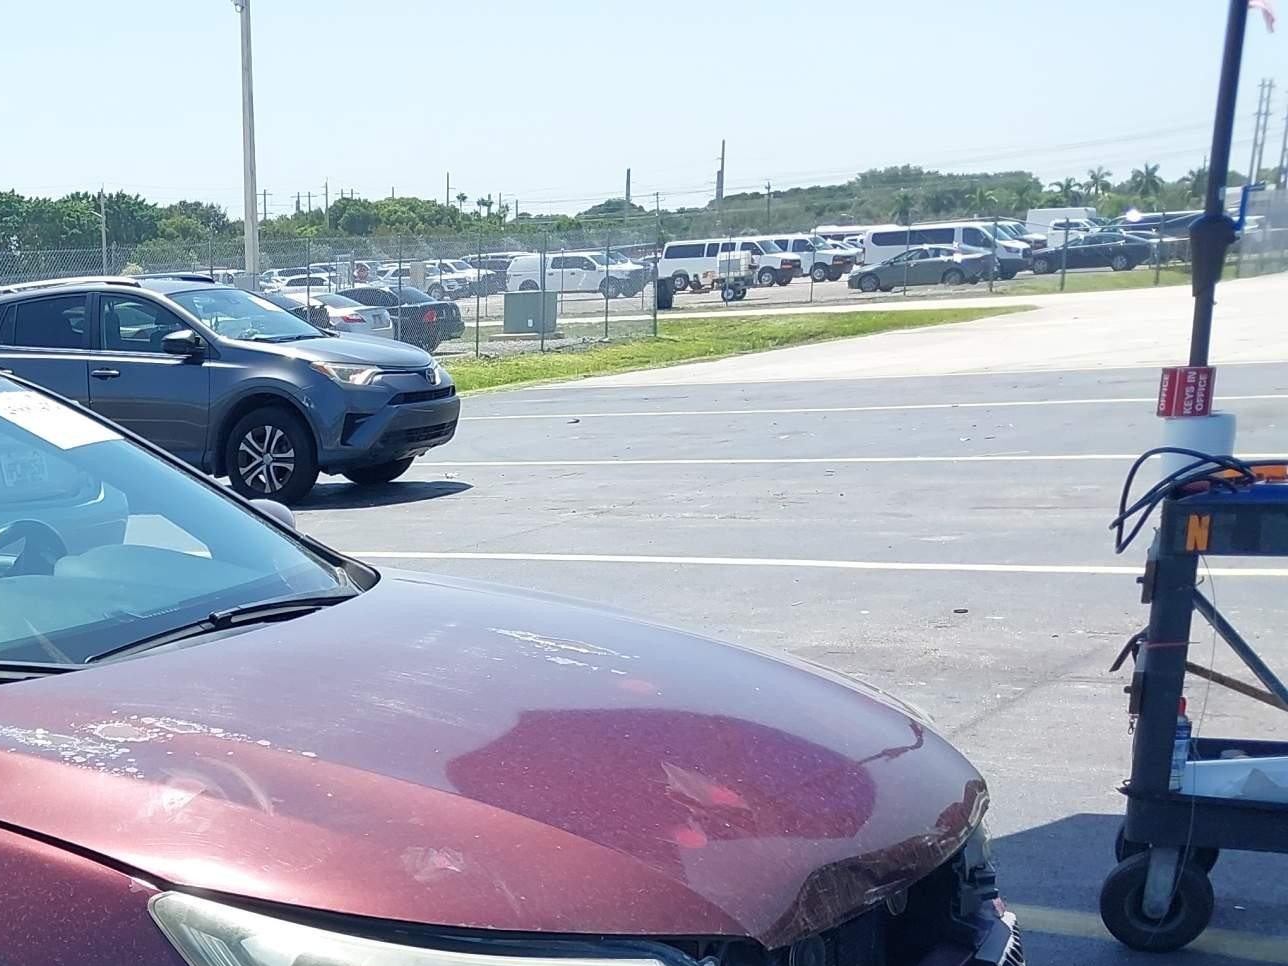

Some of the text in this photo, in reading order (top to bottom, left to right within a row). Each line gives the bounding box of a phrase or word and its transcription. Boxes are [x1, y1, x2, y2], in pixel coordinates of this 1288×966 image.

[1159, 374, 1170, 411] OFFICE
[1183, 371, 1197, 414] KEYS IN
[1195, 373, 1208, 411] OFFICE
[1186, 514, 1210, 551] N
